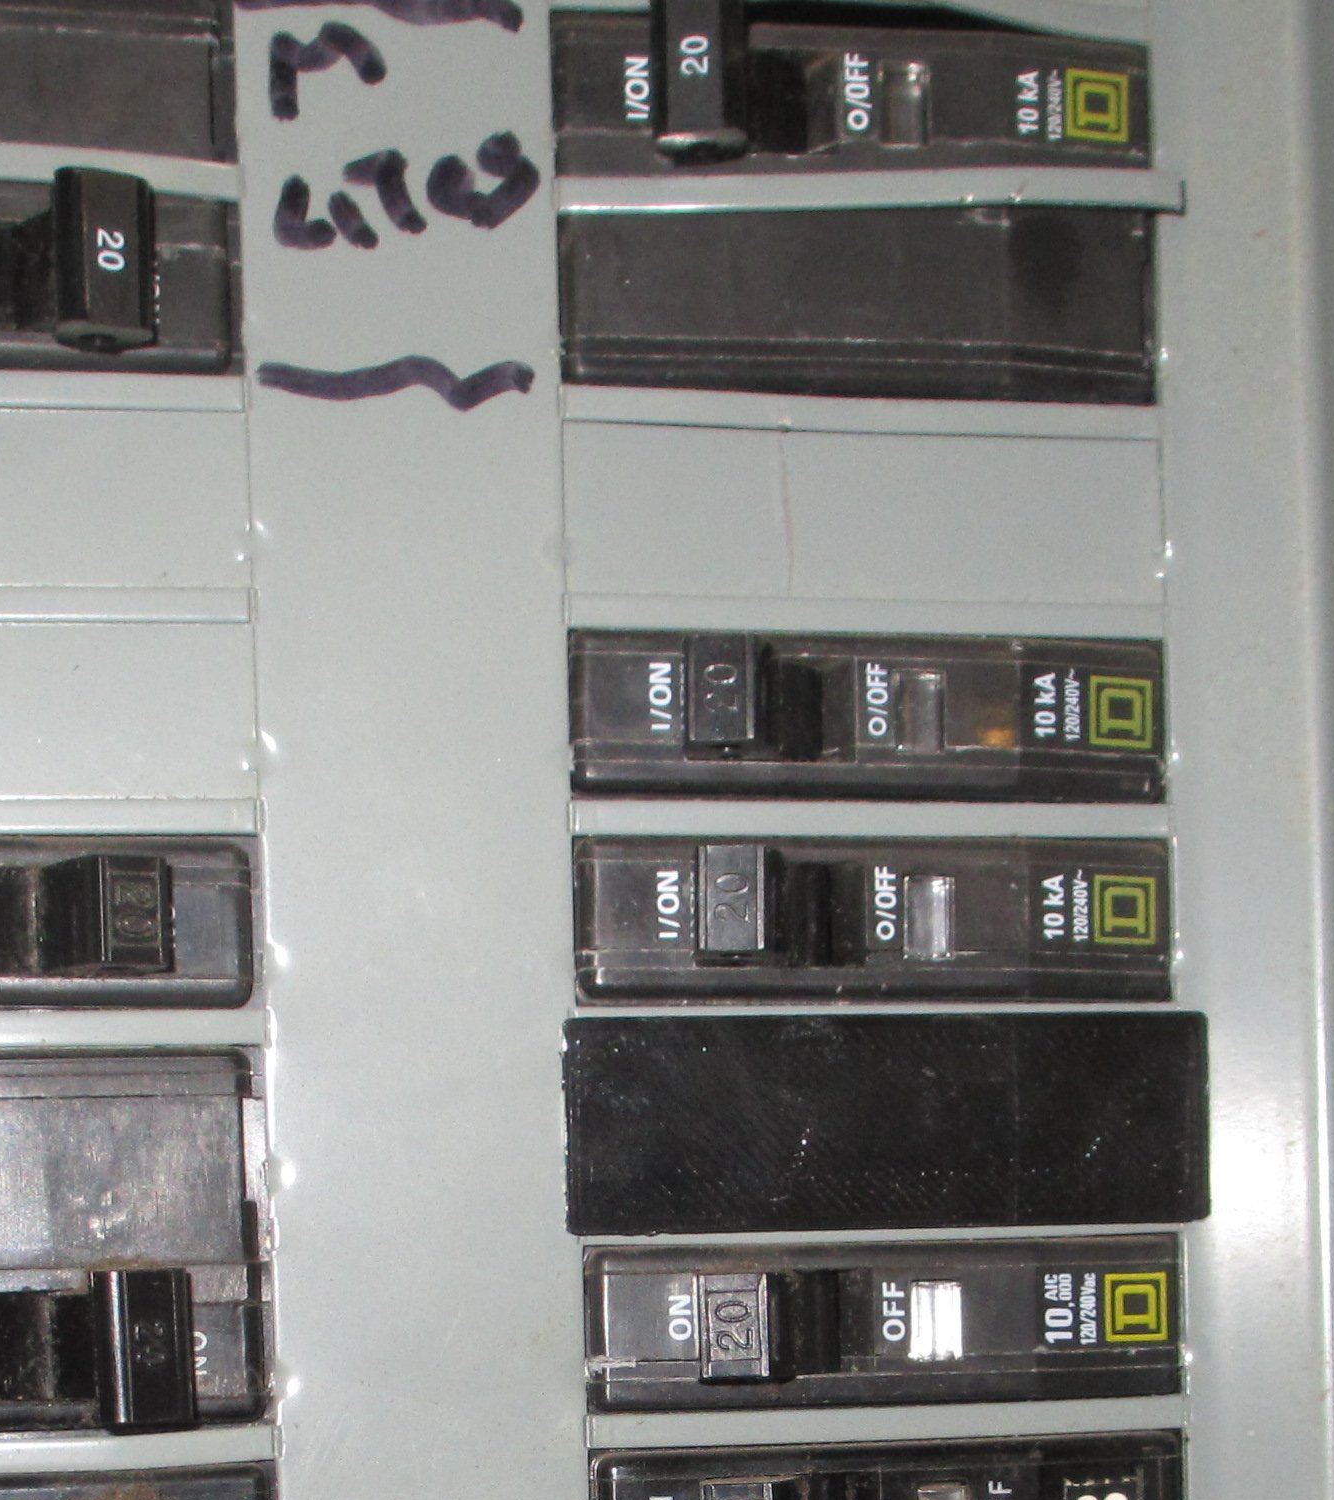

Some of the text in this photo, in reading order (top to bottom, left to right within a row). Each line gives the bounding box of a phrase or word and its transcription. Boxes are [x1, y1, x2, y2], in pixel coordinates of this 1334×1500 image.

[624, 55, 651, 122] I/ON
[679, 34, 709, 77] 20
[843, 52, 872, 132] O/OFF
[1017, 69, 1040, 135] 10 kA
[96, 228, 126, 272] 20
[648, 661, 672, 732] I/ON
[866, 662, 889, 737] O/OFF
[1034, 671, 1056, 738] 10 kA
[656, 870, 681, 939] I/ON
[713, 872, 749, 922] 20
[875, 865, 898, 941] O/OFF
[1041, 874, 1065, 940] 10 kA
[668, 1293, 693, 1342] ON
[881, 1281, 907, 1342] OFF
[1043, 1273, 1059, 1302] AIC
[716, 1298, 755, 1352] 20
